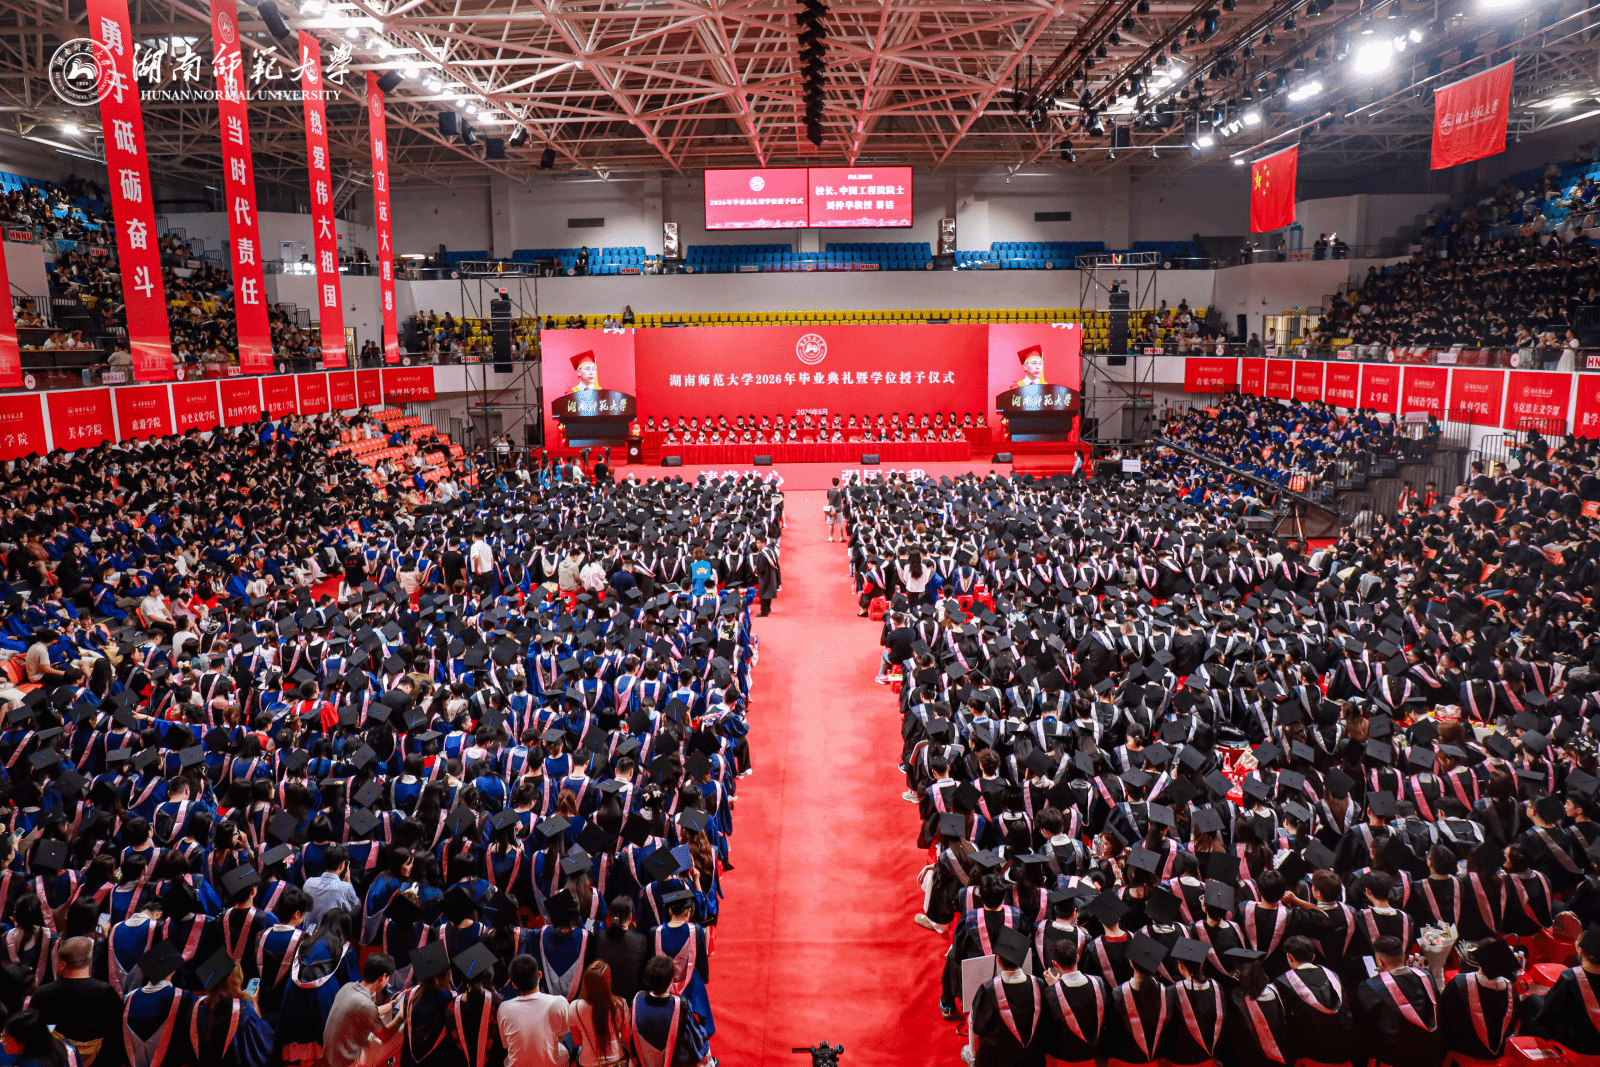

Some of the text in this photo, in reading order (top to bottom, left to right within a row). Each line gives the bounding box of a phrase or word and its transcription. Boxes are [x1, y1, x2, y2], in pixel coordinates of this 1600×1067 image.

[101, 16, 154, 298] 勇于砥砺奋斗
[310, 109, 337, 308] 热爱伟大祖国
[374, 138, 393, 311] 树立远大理想
[9, 230, 33, 241] HNNU
[669, 370, 955, 387] 湖南师范大学2026年毕业典礼暨学位授予仪式
[1369, 391, 1389, 403] 文学院
[180, 410, 216, 424] 历史文化学院
[1512, 402, 1561, 417] 马克思主义学部
[68, 423, 104, 440] 美术学院
[131, 417, 162, 431] 旅游学院
[0, 432, 29, 448] 学院
